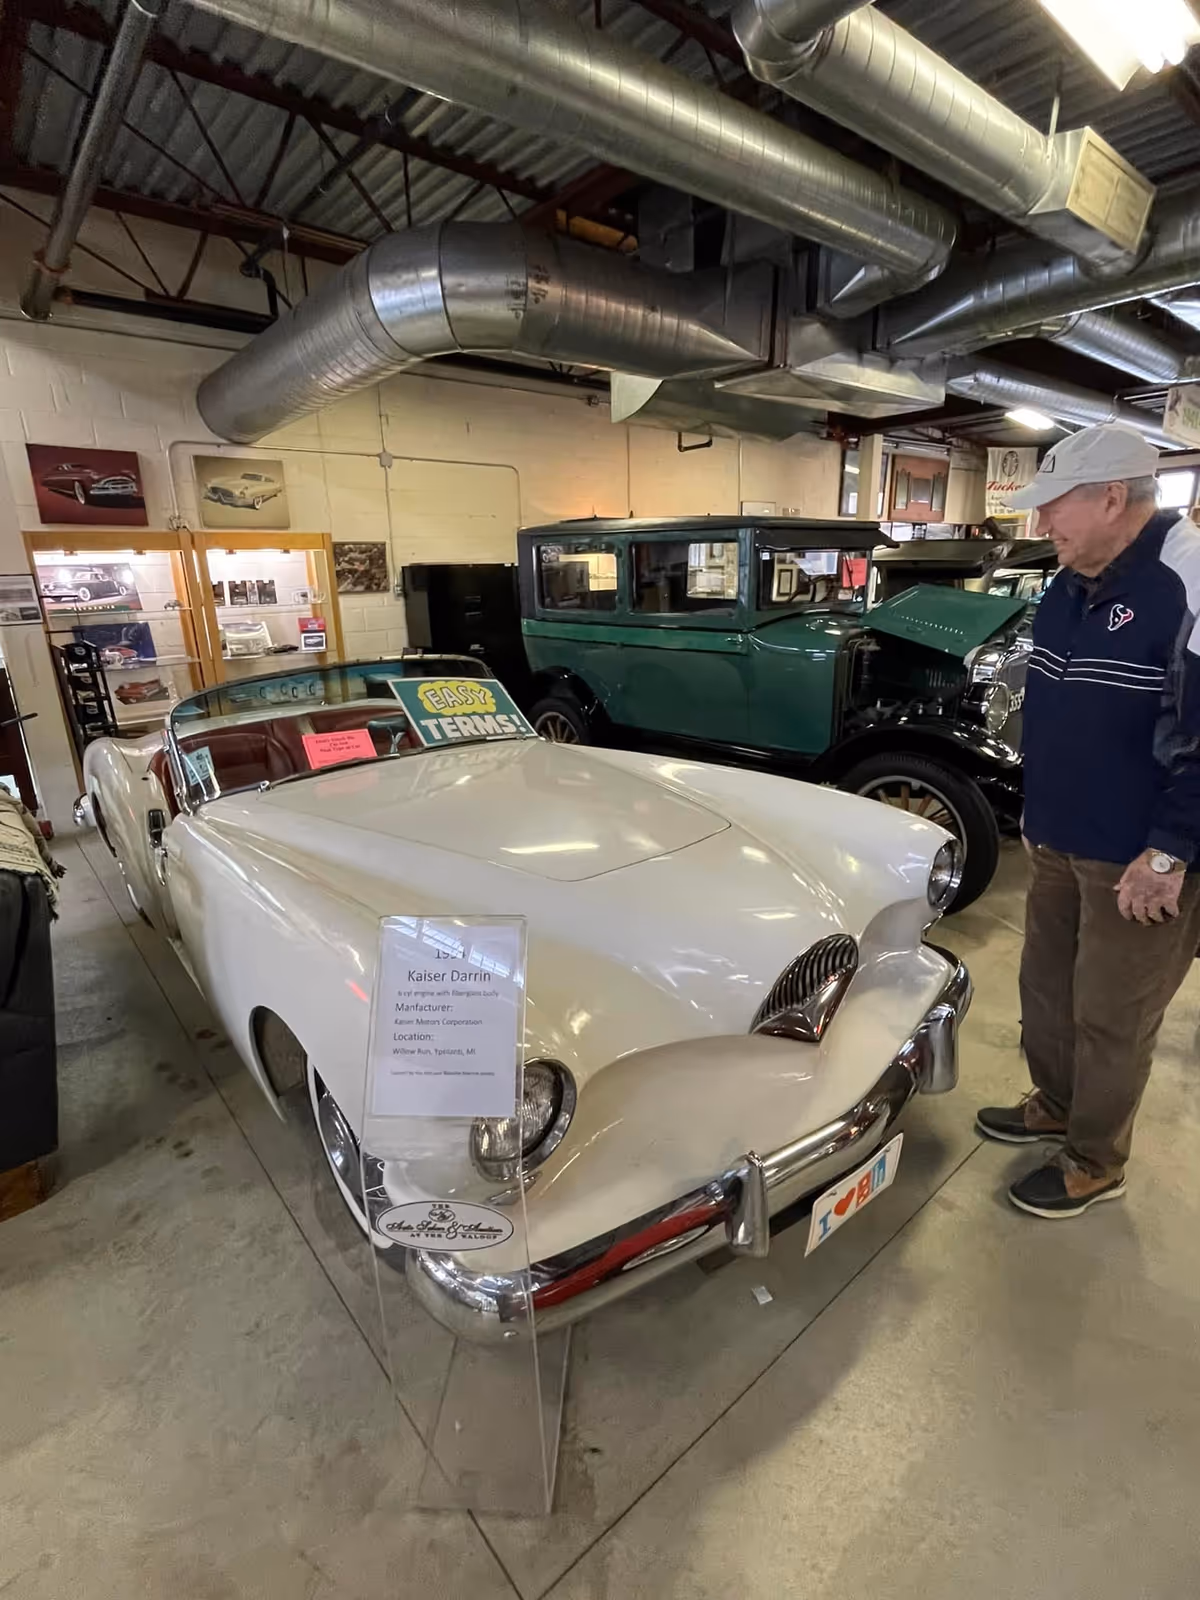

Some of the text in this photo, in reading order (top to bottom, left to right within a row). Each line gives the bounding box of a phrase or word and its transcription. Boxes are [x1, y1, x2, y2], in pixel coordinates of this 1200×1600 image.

[424, 685, 487, 711] EASY
[420, 714, 527, 740] TERMS!
[407, 970, 491, 982] Kaiser Darrin
[395, 1002, 454, 1013] Manfacturer:
[415, 1018, 441, 1026] Motors
[442, 1018, 483, 1027] Corporation
[393, 1032, 434, 1042] Location:
[818, 1209, 832, 1242] I
